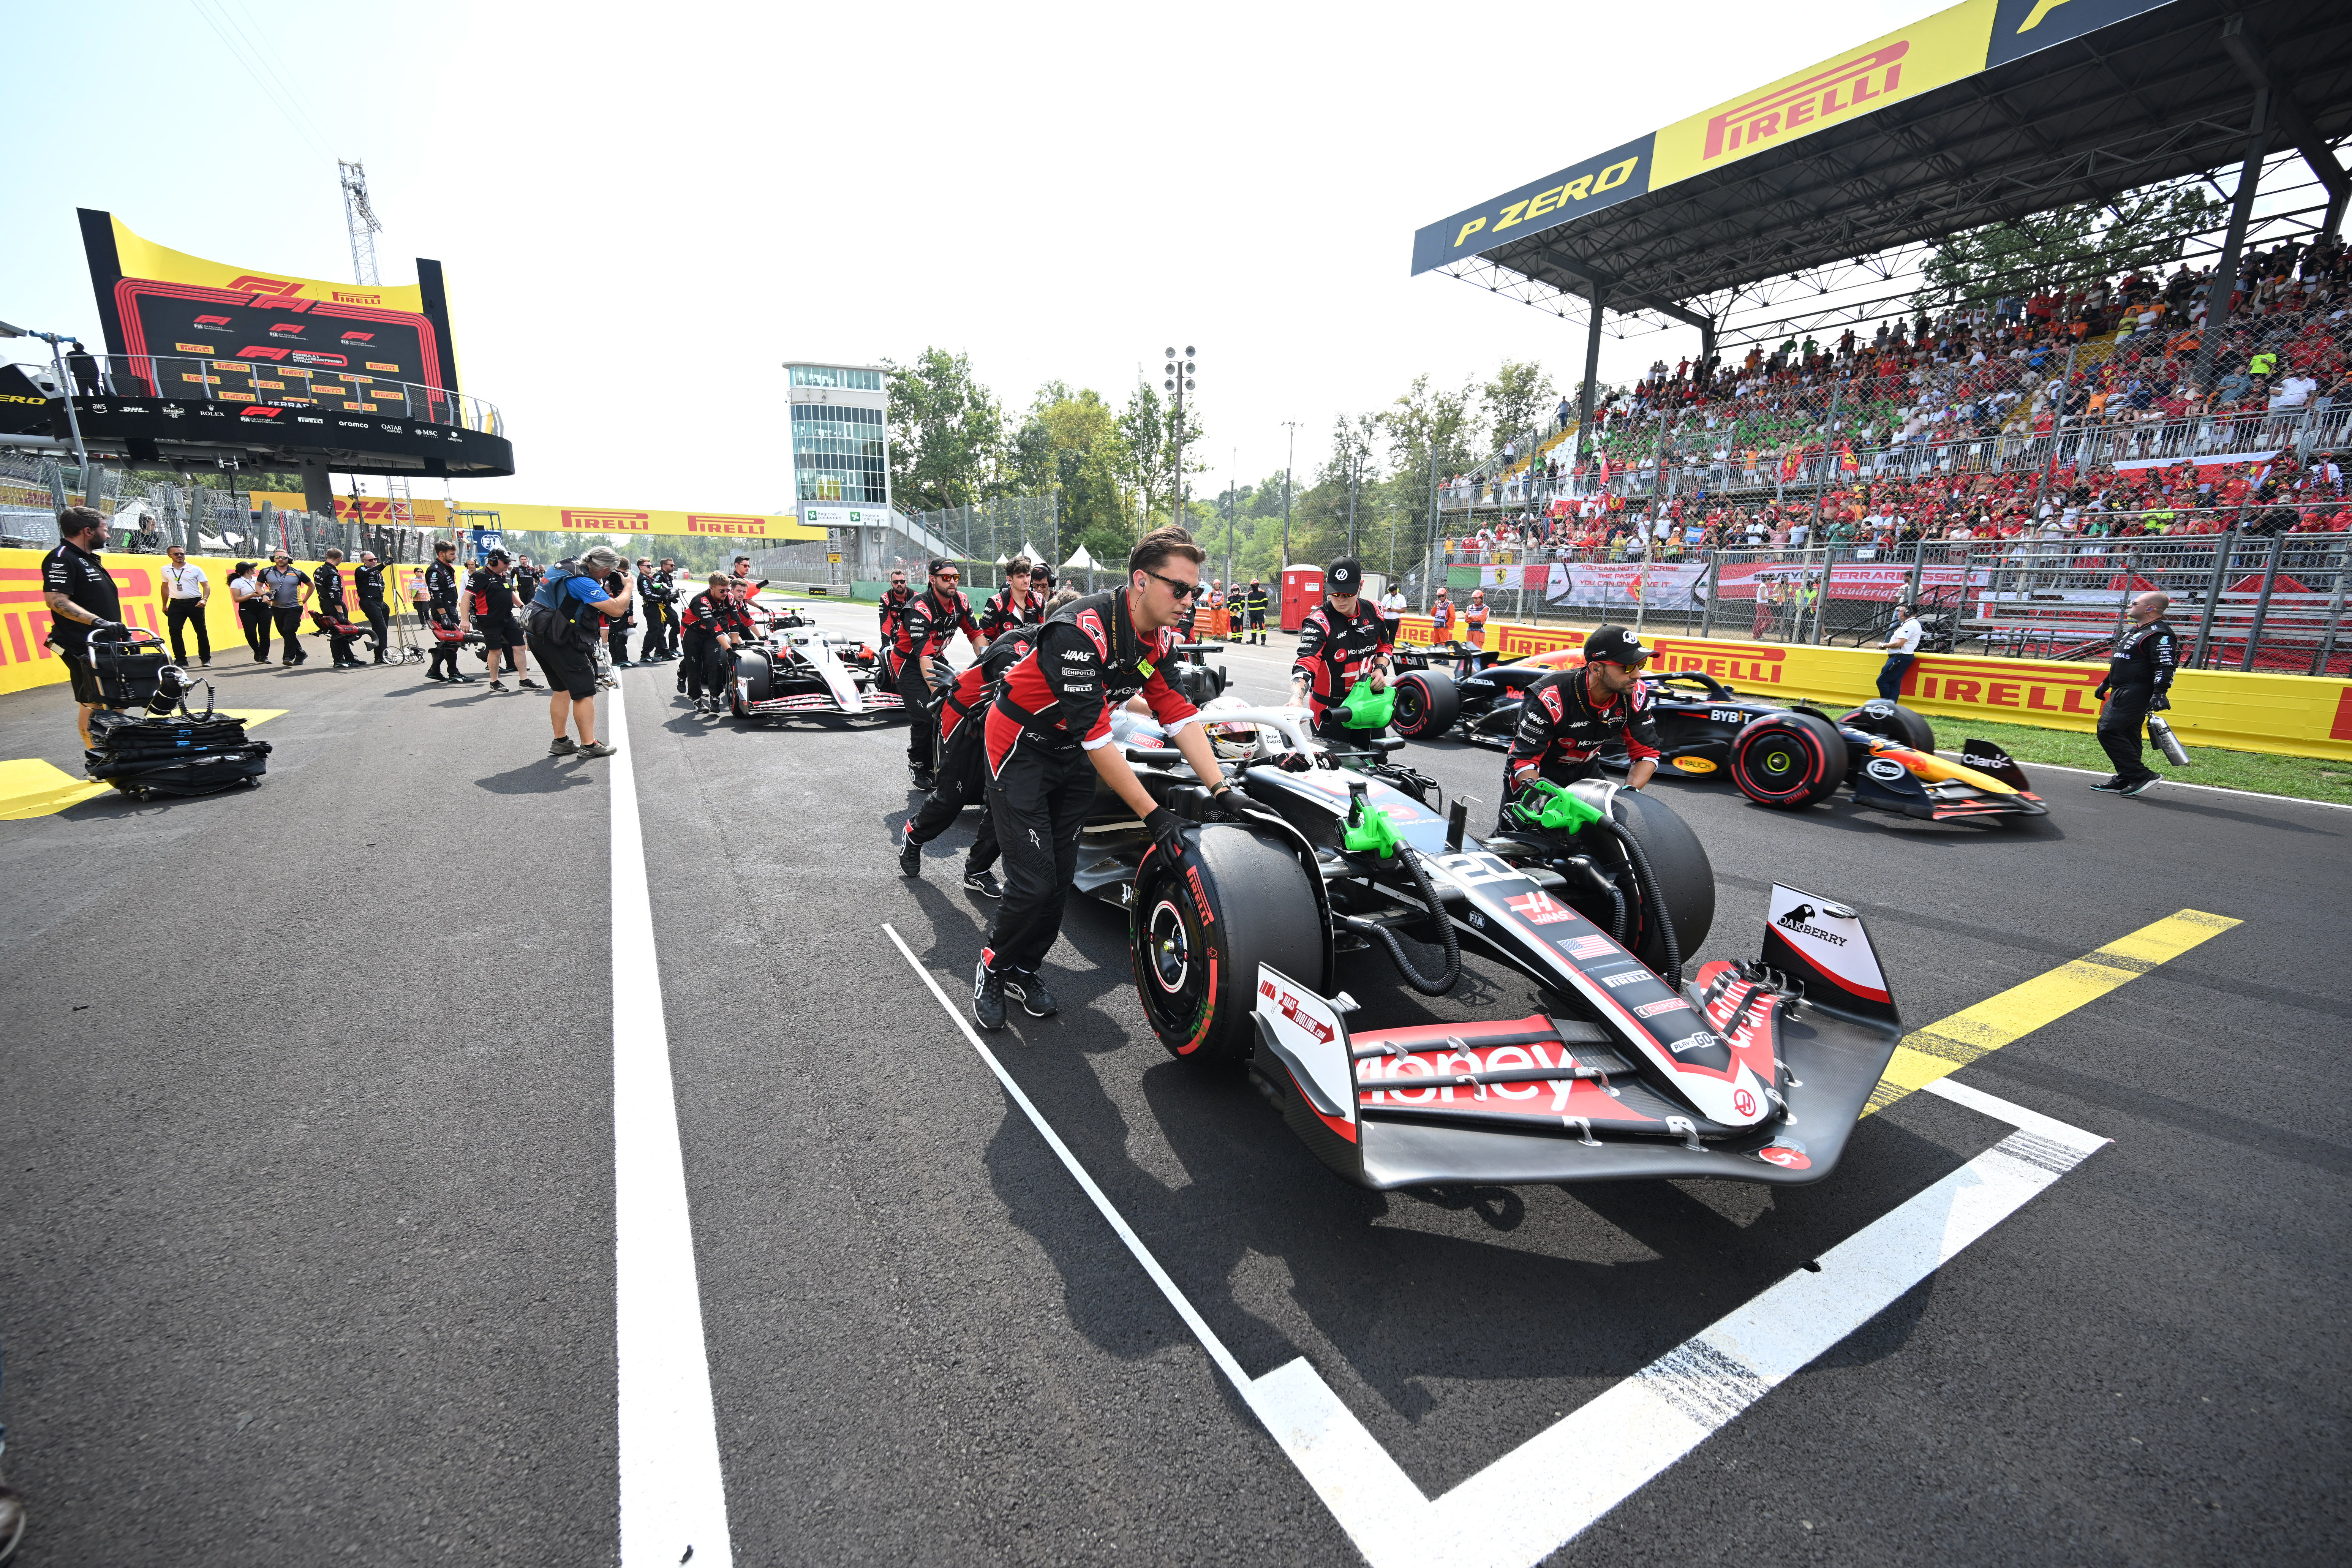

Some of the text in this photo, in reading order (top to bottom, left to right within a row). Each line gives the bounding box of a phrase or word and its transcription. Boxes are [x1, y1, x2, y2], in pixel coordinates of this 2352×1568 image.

[1703, 39, 1909, 161] PIRELLI
[1454, 156, 1638, 247] P ZERO
[332, 291, 380, 304] PIRELLI
[180, 344, 210, 353] PIRELLI
[561, 510, 649, 530] PIRELLI
[688, 515, 765, 534] PIRELLI
[1336, 631, 1348, 639] HAAS
[1061, 650, 1095, 662] HAAS
[1394, 655, 1418, 665] Mobil
[1652, 640, 1786, 683] PIRELLI
[1527, 711, 1549, 725] HAAS
[1710, 710, 1753, 724] BYBIT
[1525, 724, 1543, 734] CHIPOTLE
[1134, 735, 1161, 749] CHIPOTLE
[1685, 760, 1711, 770] RAUCH
[1963, 754, 2002, 768] Claro
[1872, 763, 1898, 775] Esso
[1186, 865, 1214, 927] PIRELLI
[1469, 915, 1484, 927] FIA
[1531, 910, 1569, 923] HAAS
[1778, 916, 1847, 947] OAKBERRY
[1601, 970, 1654, 988] PIRELLI
[1282, 995, 1296, 1010] HAAS
[1649, 1000, 1687, 1012] CHIPOTLE
[1694, 1033, 1713, 1046] GO
